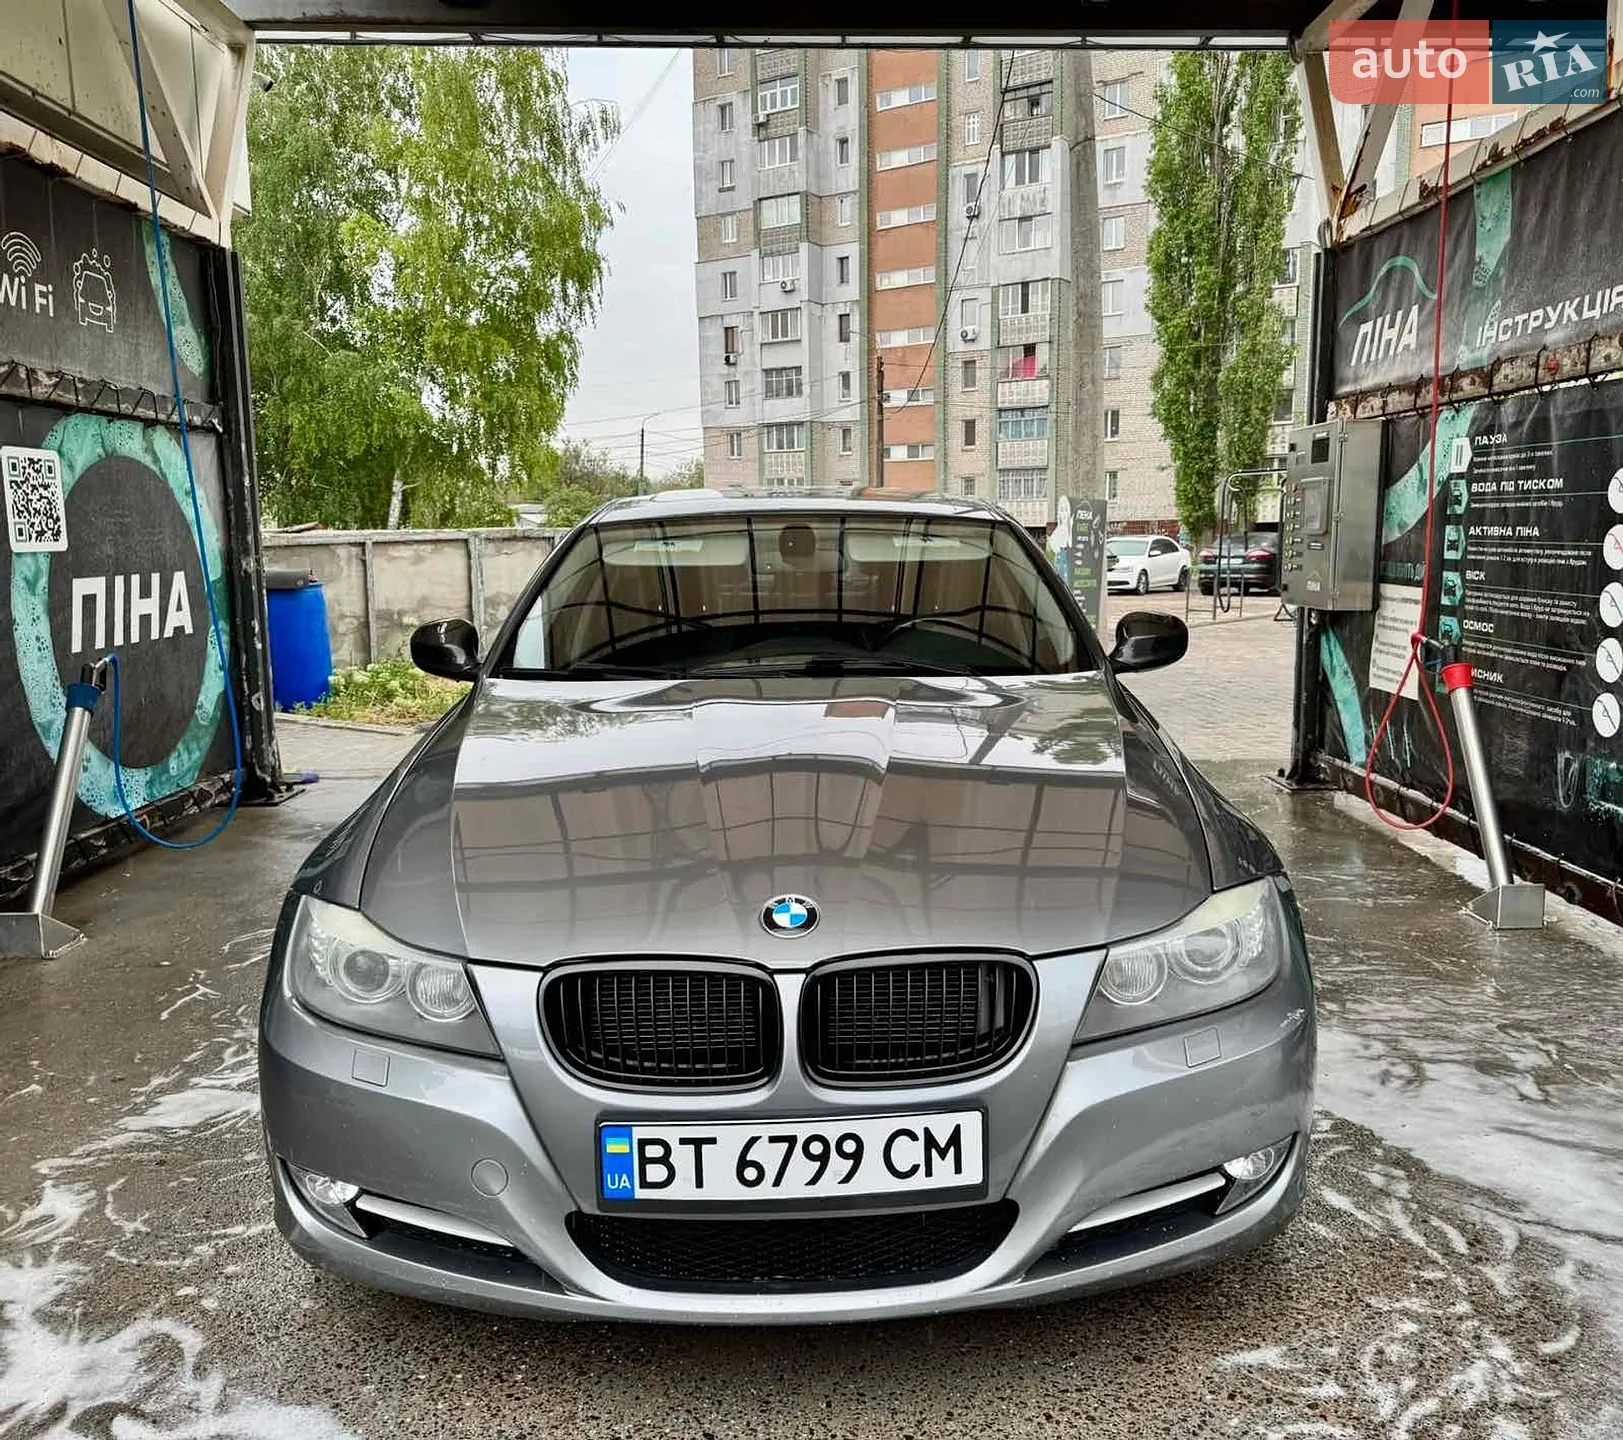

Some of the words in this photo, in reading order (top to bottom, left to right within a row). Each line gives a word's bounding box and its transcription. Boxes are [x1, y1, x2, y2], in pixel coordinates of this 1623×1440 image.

[34, 283, 54, 317] Fi
[1350, 303, 1419, 366] ПІНА
[1474, 432, 1508, 446] ПАУЗА
[1471, 482, 1497, 493] ВОДА
[1517, 478, 1564, 490] ТИСКОМ
[1468, 525, 1513, 537] АКТИВНА
[1515, 526, 1540, 537] ПІНА
[71, 570, 194, 654] ПІНА
[1463, 619, 1494, 633] ОСМОС
[637, 1137, 717, 1190] BT
[735, 1131, 865, 1189] 6799
[882, 1123, 964, 1180] CM
[607, 1173, 632, 1190] UA
